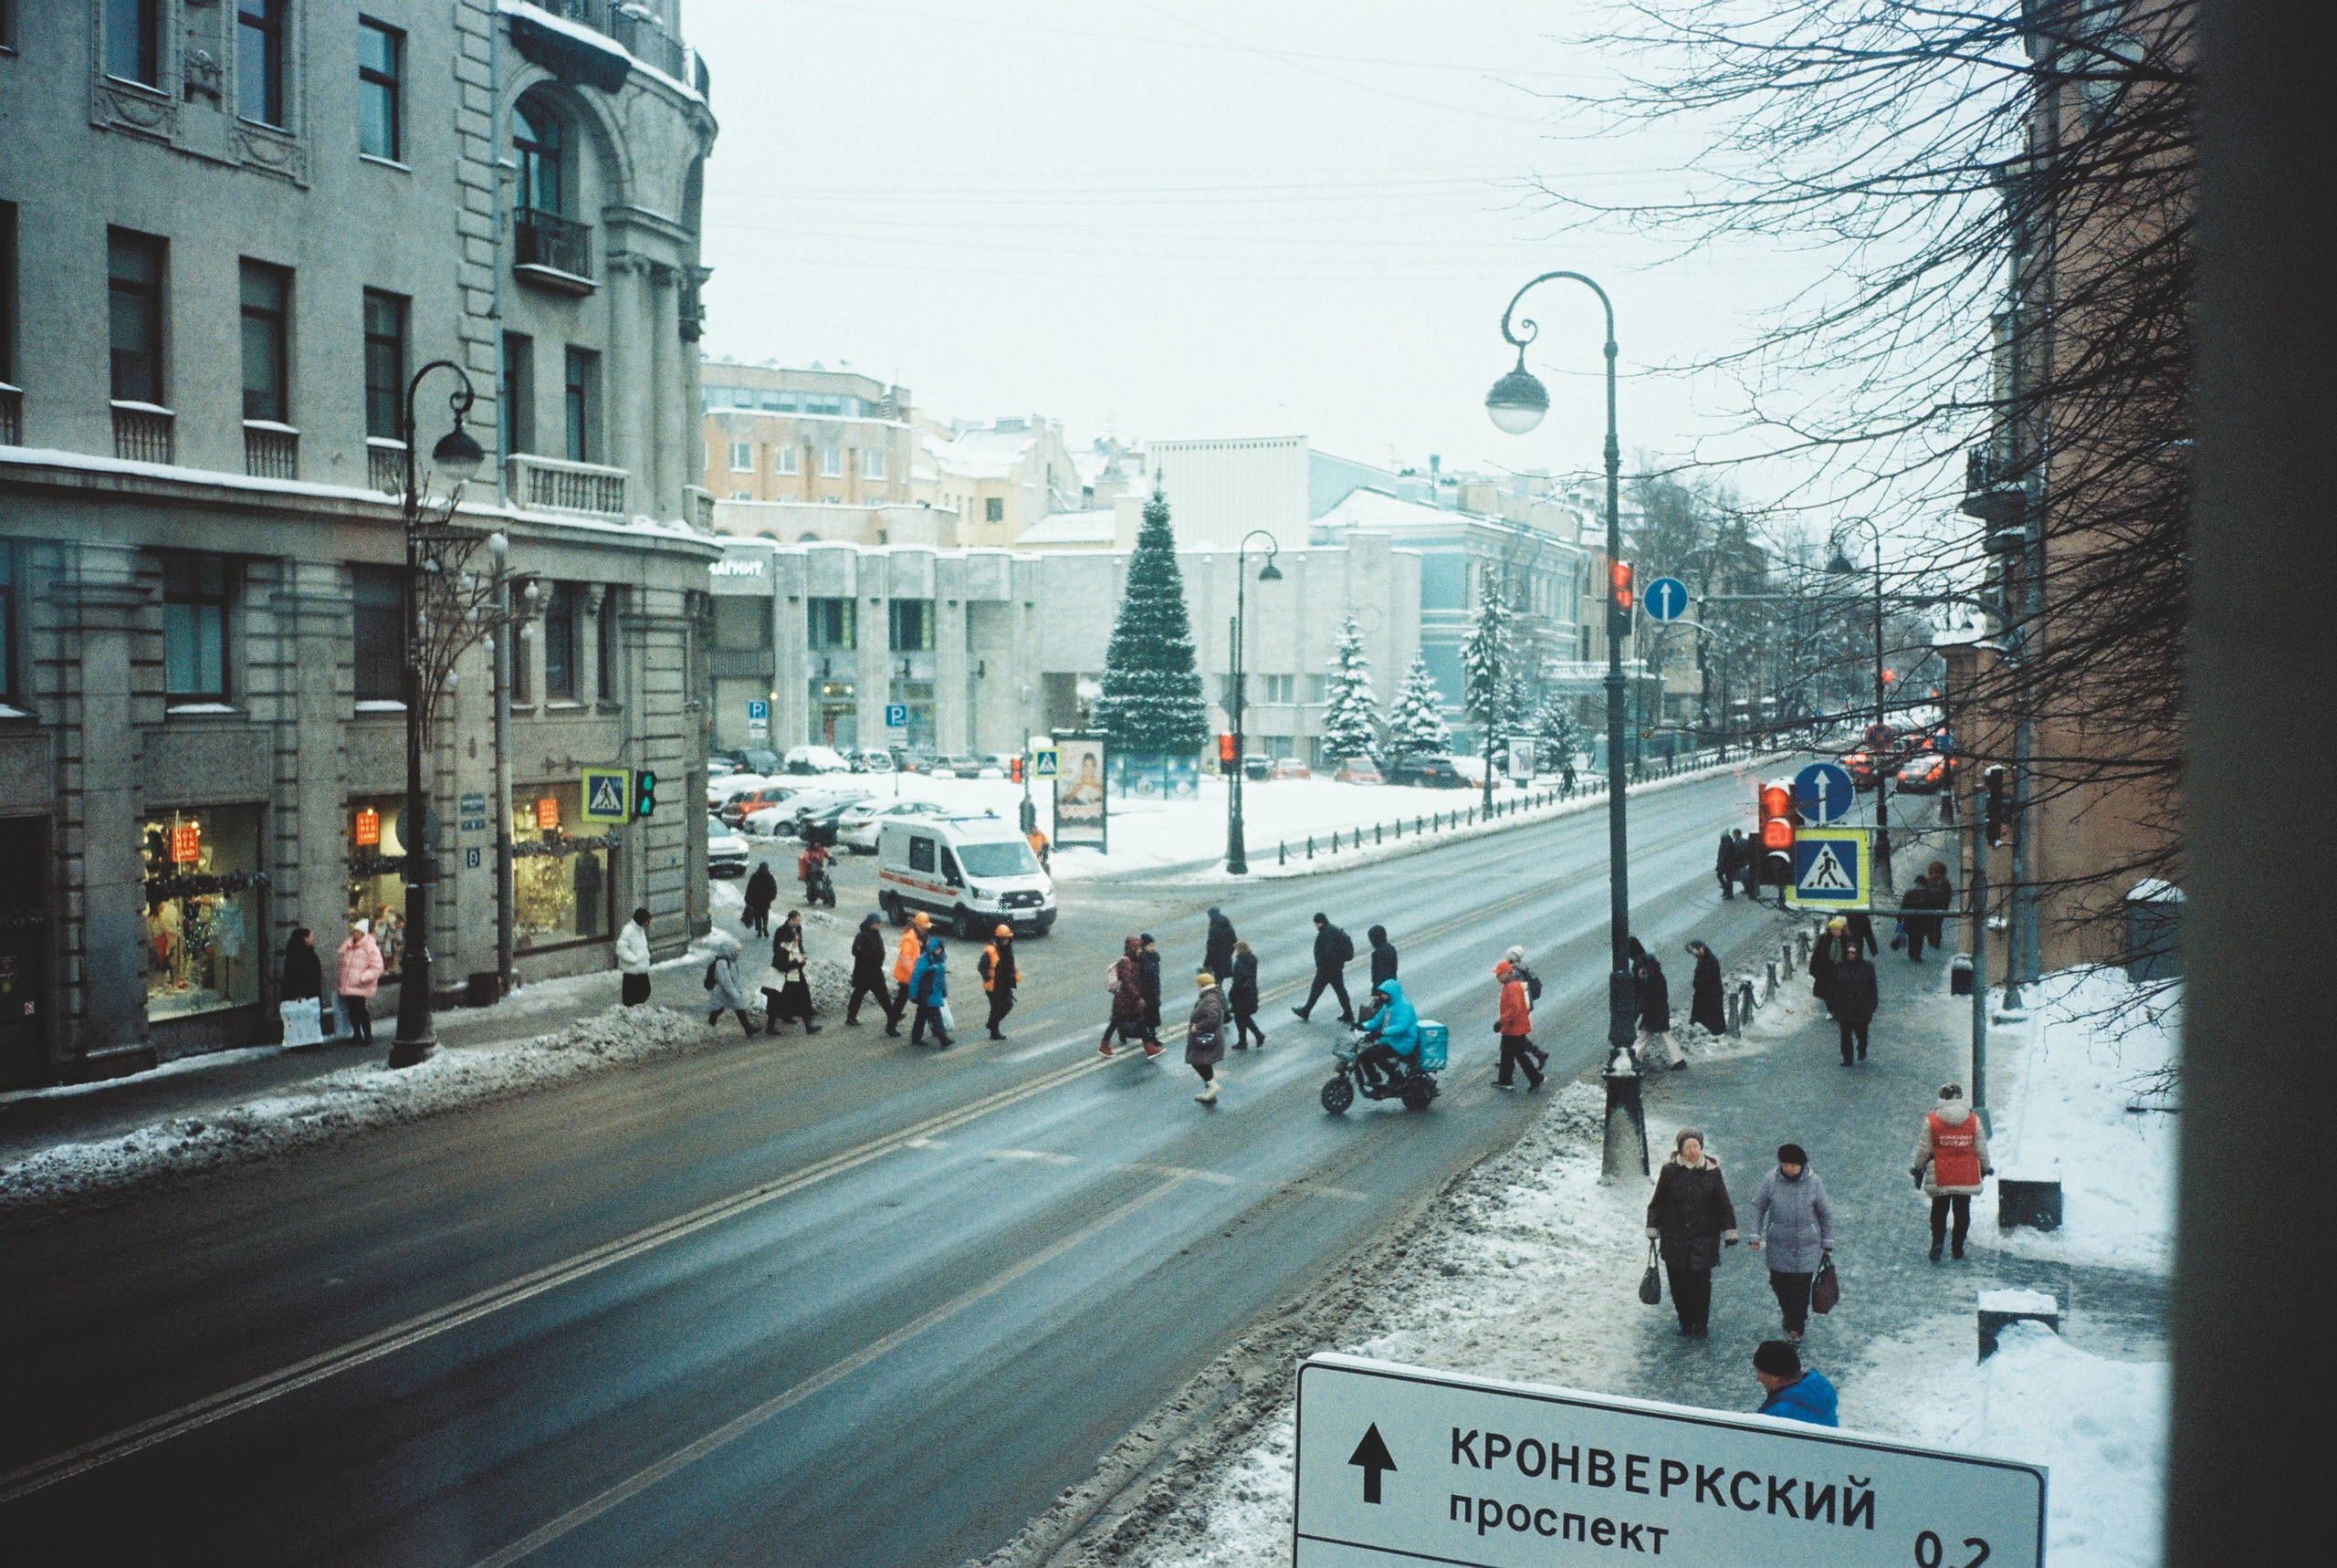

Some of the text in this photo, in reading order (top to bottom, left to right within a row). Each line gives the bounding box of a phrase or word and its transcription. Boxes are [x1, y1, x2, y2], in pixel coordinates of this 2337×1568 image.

[753, 703, 762, 717] P
[892, 707, 903, 725] P
[1452, 1427, 1875, 1531] КРОНВЕРКСКИЙ
[1451, 1494, 1669, 1554] проспект
[1914, 1531, 1991, 1568] 02
